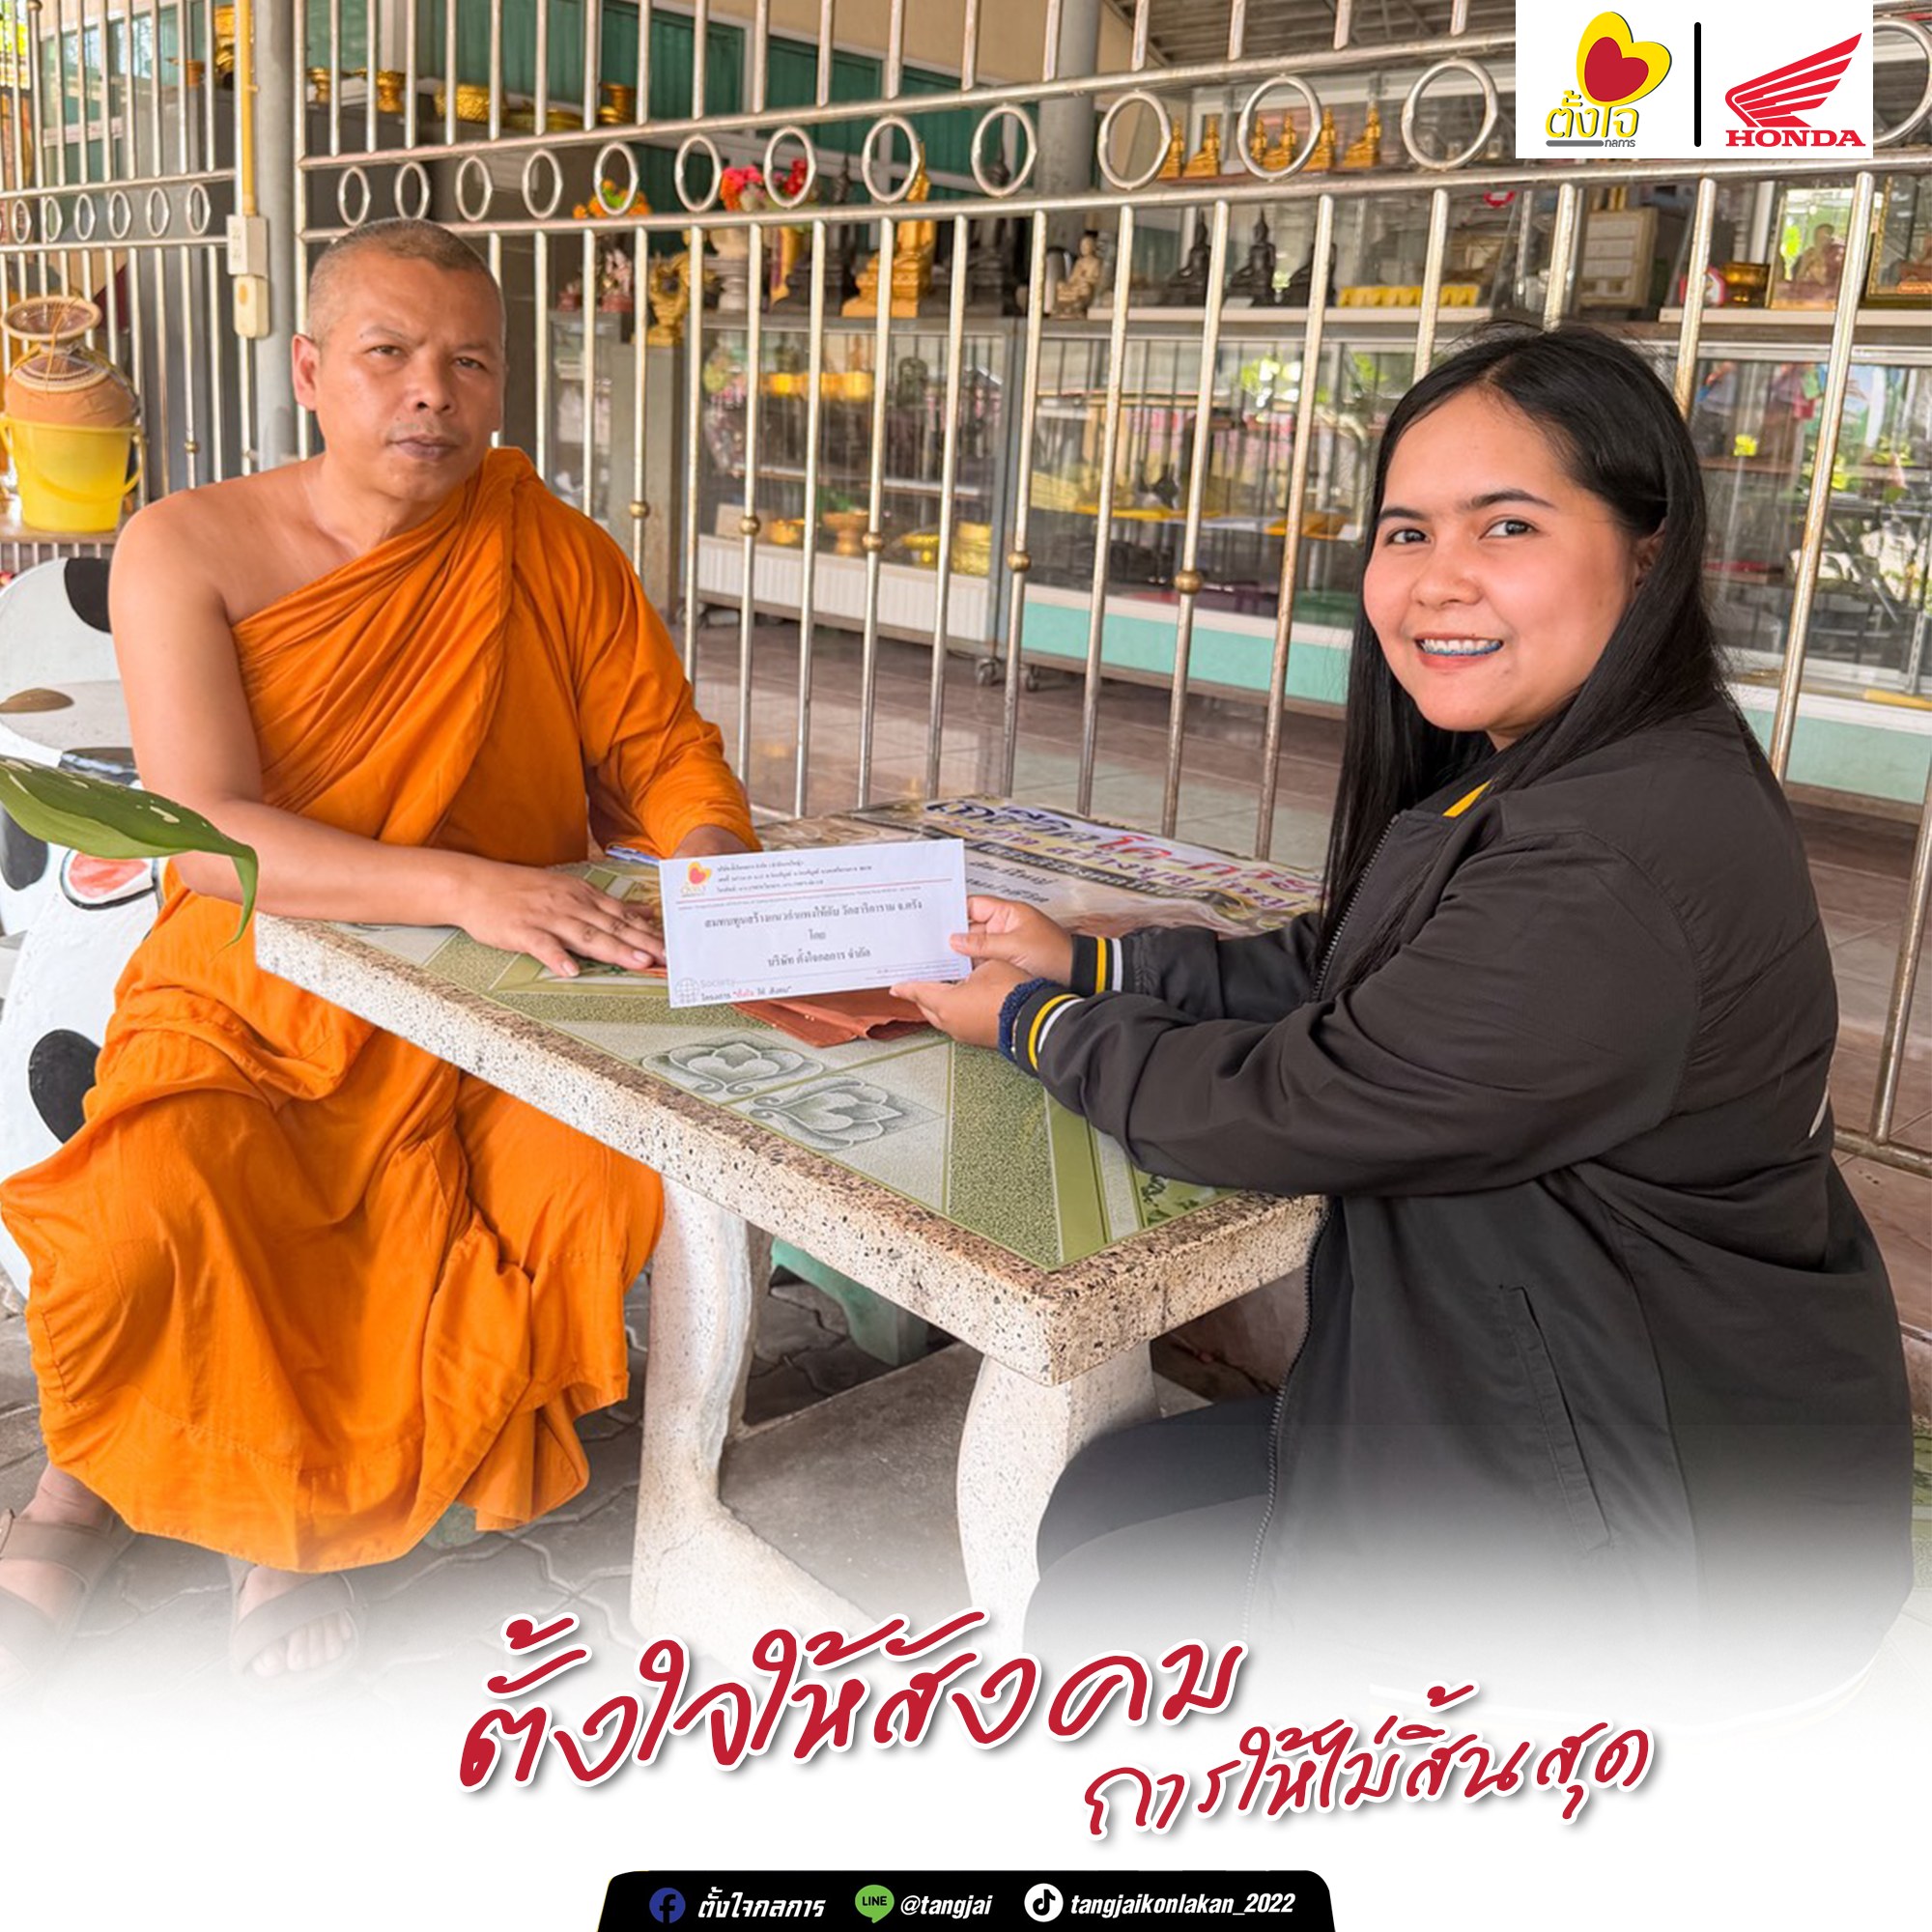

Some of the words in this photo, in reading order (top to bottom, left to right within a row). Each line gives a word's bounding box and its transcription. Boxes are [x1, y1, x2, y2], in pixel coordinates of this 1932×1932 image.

[809, 929, 826, 940] โดย
[768, 953, 795, 967] บริษัท
[847, 947, 871, 959] จำกัด
